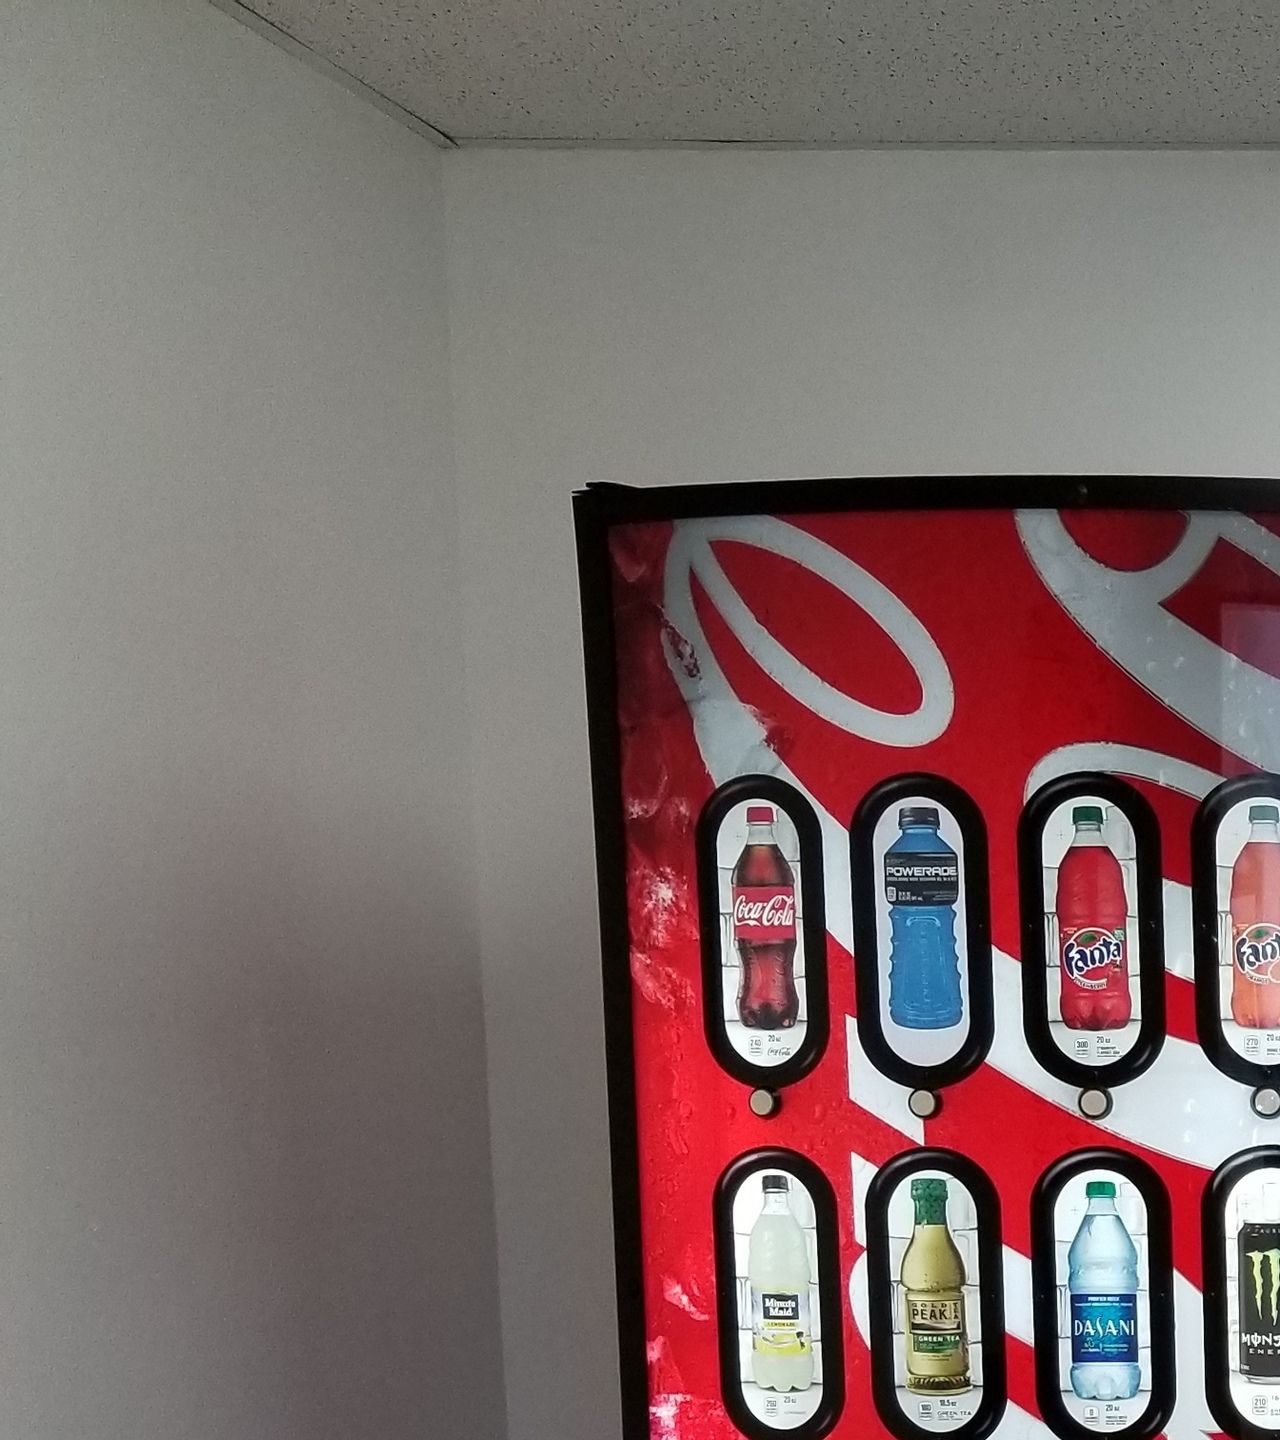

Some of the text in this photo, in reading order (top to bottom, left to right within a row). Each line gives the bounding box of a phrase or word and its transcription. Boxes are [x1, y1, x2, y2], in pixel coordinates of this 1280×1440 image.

[886, 866, 958, 877] POWERADE
[734, 895, 794, 927] Coca-Cola
[1063, 936, 1122, 979] Fanta
[1246, 1038, 1258, 1046] 270
[1267, 1034, 1274, 1042] 20
[769, 1307, 793, 1316] Maid
[912, 1309, 948, 1320] PEAK
[1074, 1316, 1135, 1338] DASANI
[1254, 1398, 1266, 1406] 210
